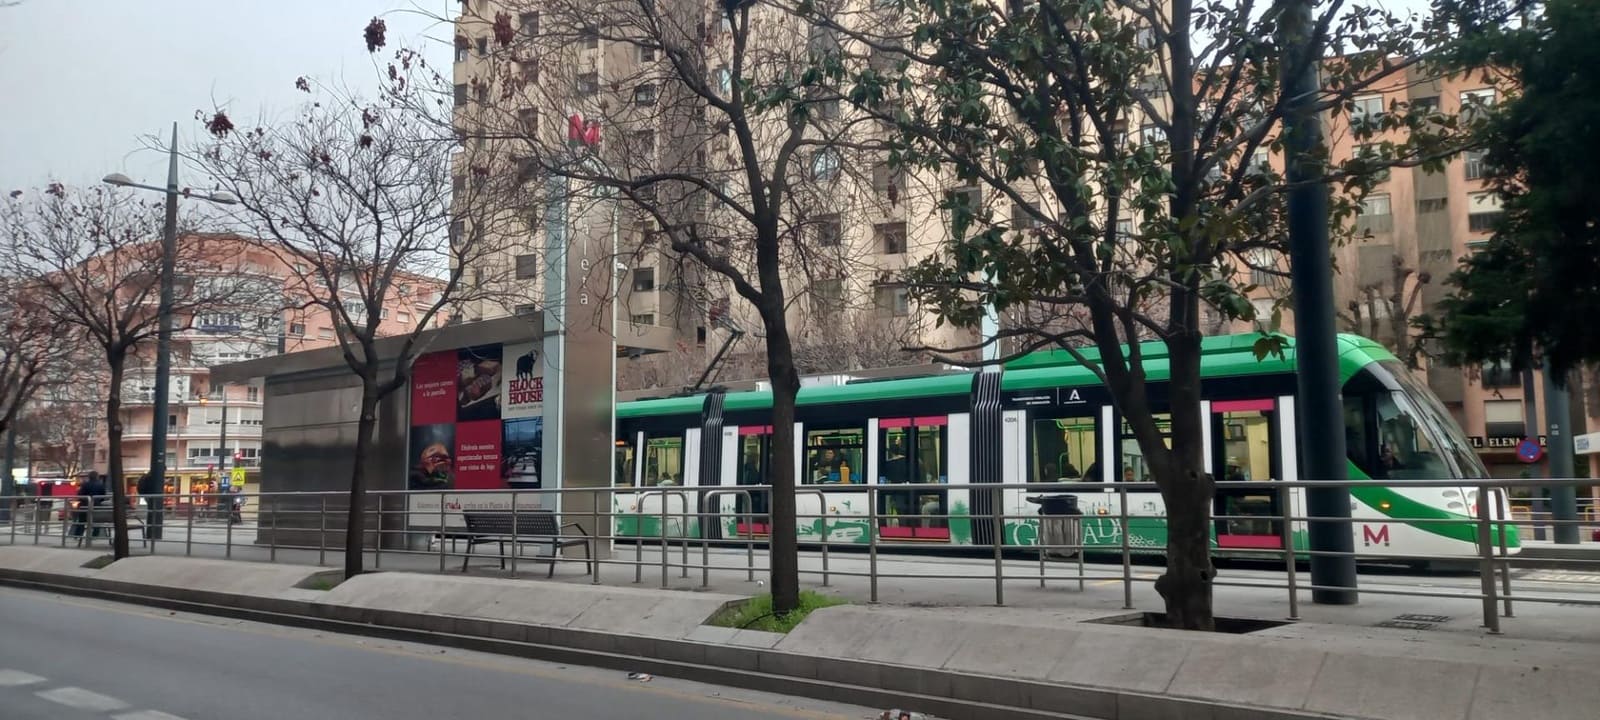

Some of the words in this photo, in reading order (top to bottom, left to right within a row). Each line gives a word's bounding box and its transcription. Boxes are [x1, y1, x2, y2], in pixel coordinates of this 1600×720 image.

[509, 377, 543, 392] BLOCK
[509, 390, 543, 404] HOUSE
[1363, 524, 1389, 545] M
